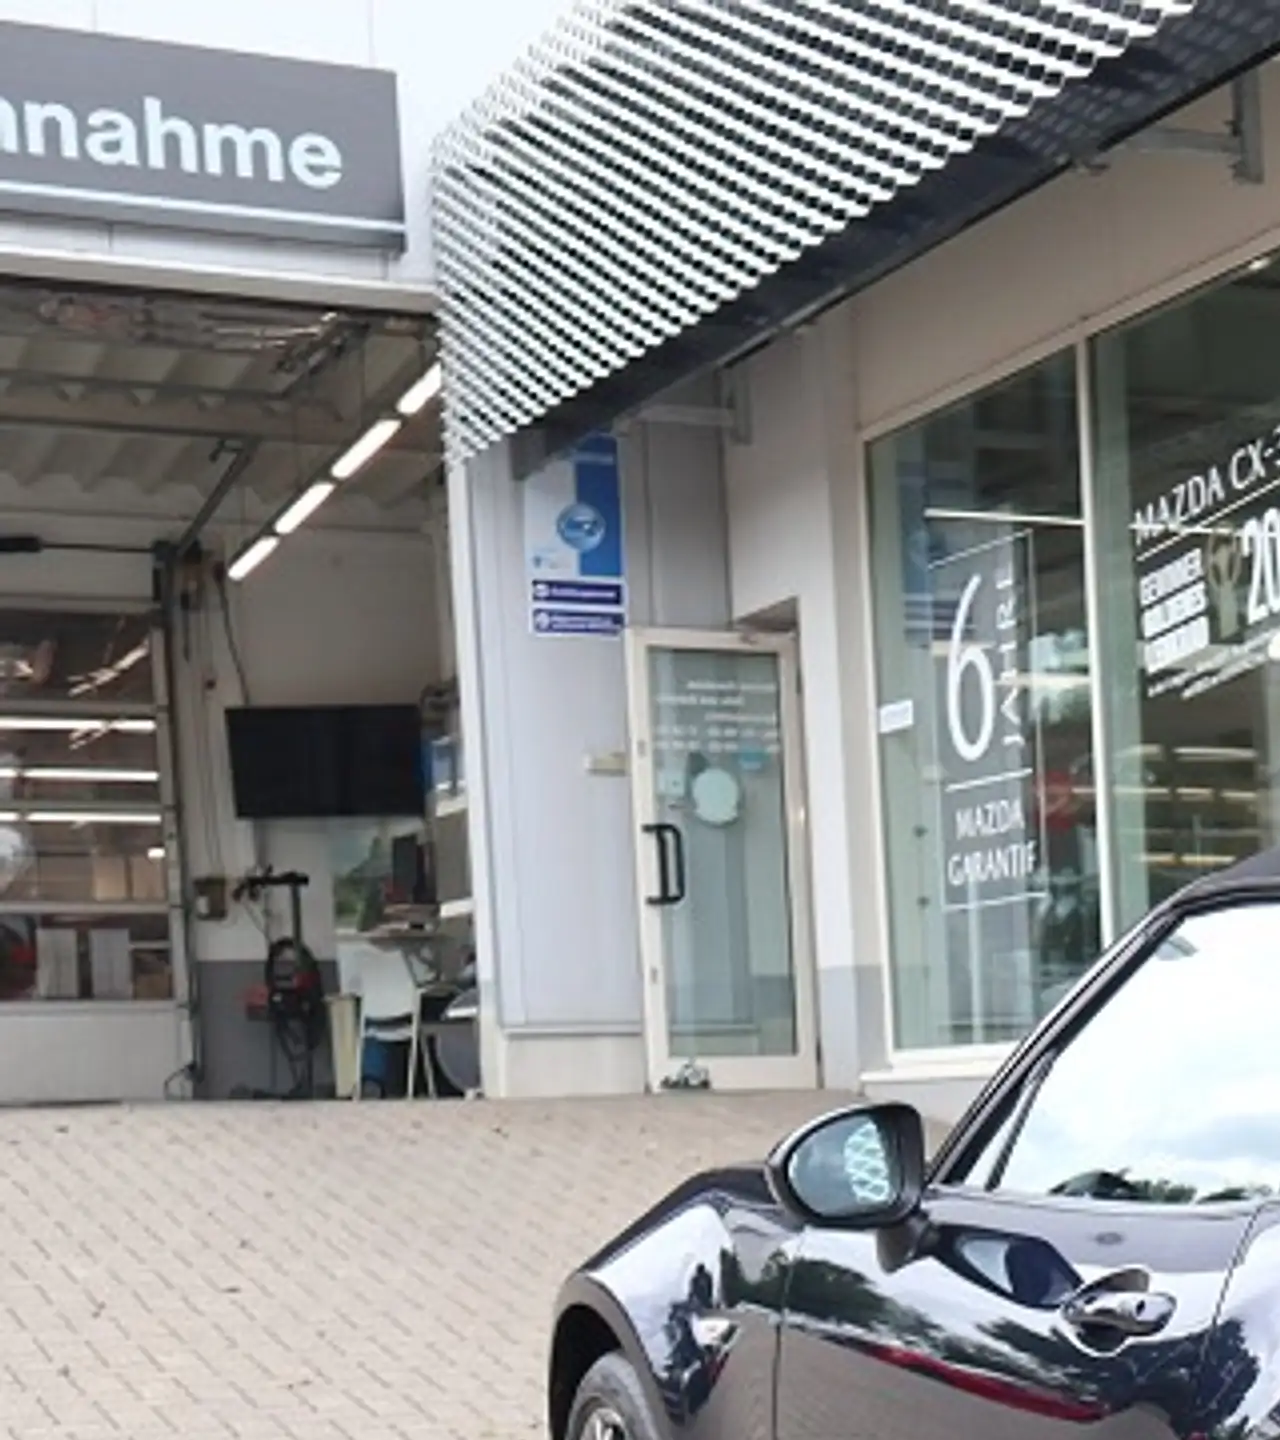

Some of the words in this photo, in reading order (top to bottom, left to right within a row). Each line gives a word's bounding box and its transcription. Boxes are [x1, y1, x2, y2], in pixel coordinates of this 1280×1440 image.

[1134, 466, 1226, 546] MAZDA
[947, 572, 995, 762] 6
[955, 797, 1025, 840] MAZDA
